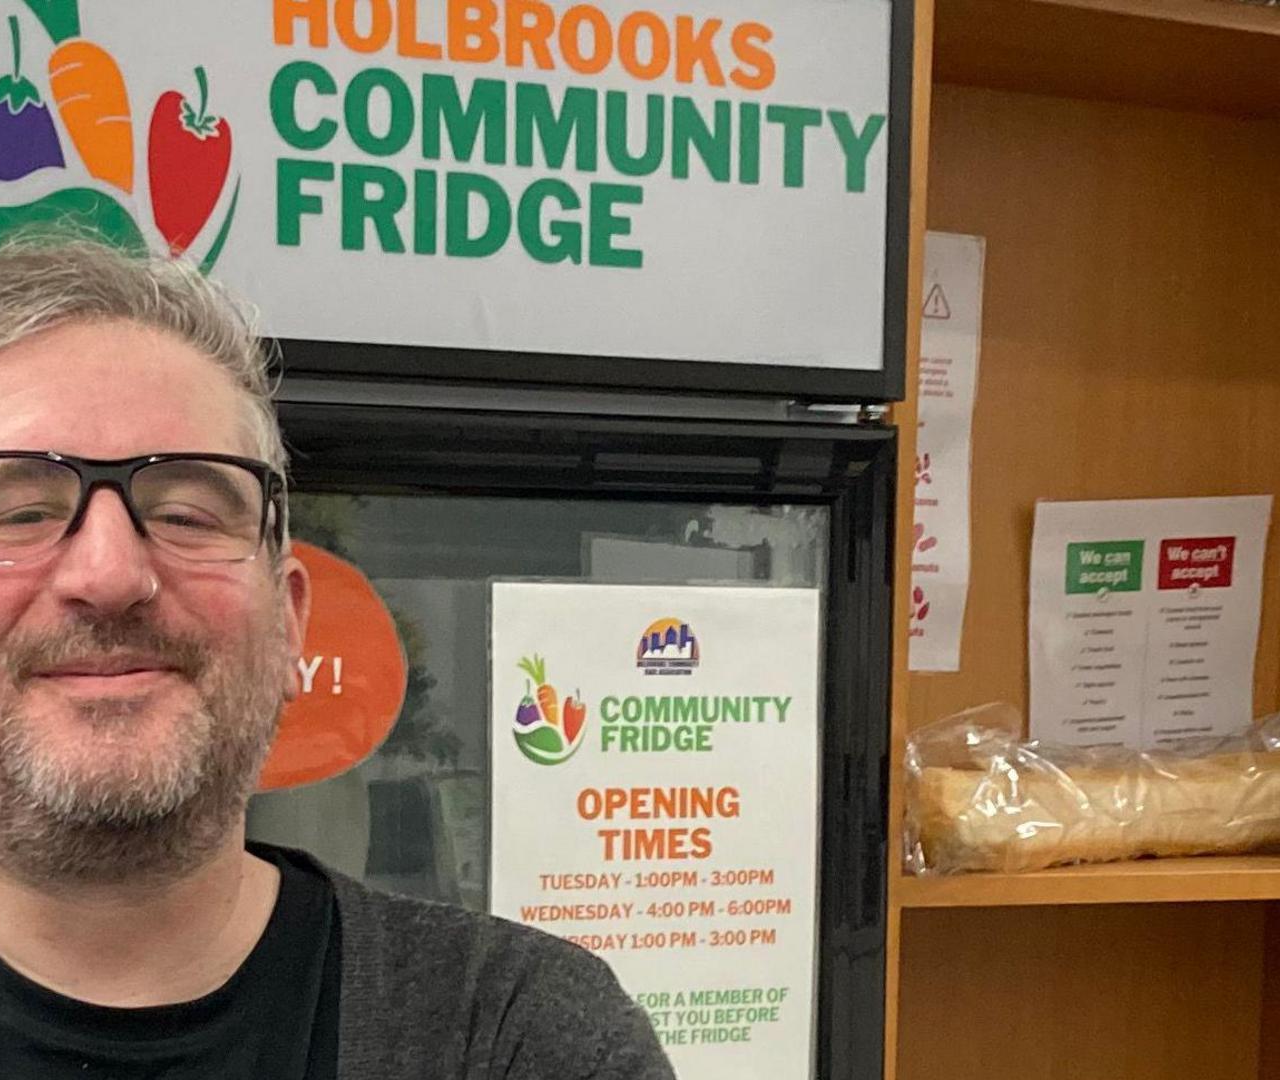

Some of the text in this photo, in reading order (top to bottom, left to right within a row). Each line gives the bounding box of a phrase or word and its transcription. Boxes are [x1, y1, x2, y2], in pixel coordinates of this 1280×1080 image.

[273, 0, 777, 91] HOLBROOKS
[269, 61, 886, 193] COMMUNITY
[276, 158, 643, 268] FRIDGE
[1079, 551, 1131, 566] We can
[1167, 547, 1189, 560] We
[1079, 569, 1128, 585] accept
[1171, 565, 1219, 581] accept
[600, 695, 792, 724] COMMUNITY
[600, 725, 713, 753] FRIDGE
[577, 787, 740, 820] OPENING
[598, 828, 713, 861] TIMES
[540, 873, 622, 890] TUESDAY
[635, 871, 697, 888] 1:00PM
[711, 869, 774, 886] 3:00PM
[521, 903, 633, 922] WEDNESDAY
[646, 902, 684, 917] 4:00
[688, 901, 715, 916] PM
[727, 899, 792, 916] 6:00PM
[562, 933, 625, 951] RSDAY
[631, 933, 666, 949] 1:00
[670, 932, 696, 947] PM
[709, 931, 745, 946] 3:00
[750, 929, 776, 944] PM
[637, 987, 789, 1008] FOR A MEMBER OF
[676, 1010, 711, 1026] YOU
[714, 1007, 780, 1024] BEFORE
[658, 1027, 751, 1045] THE FRIDGE
